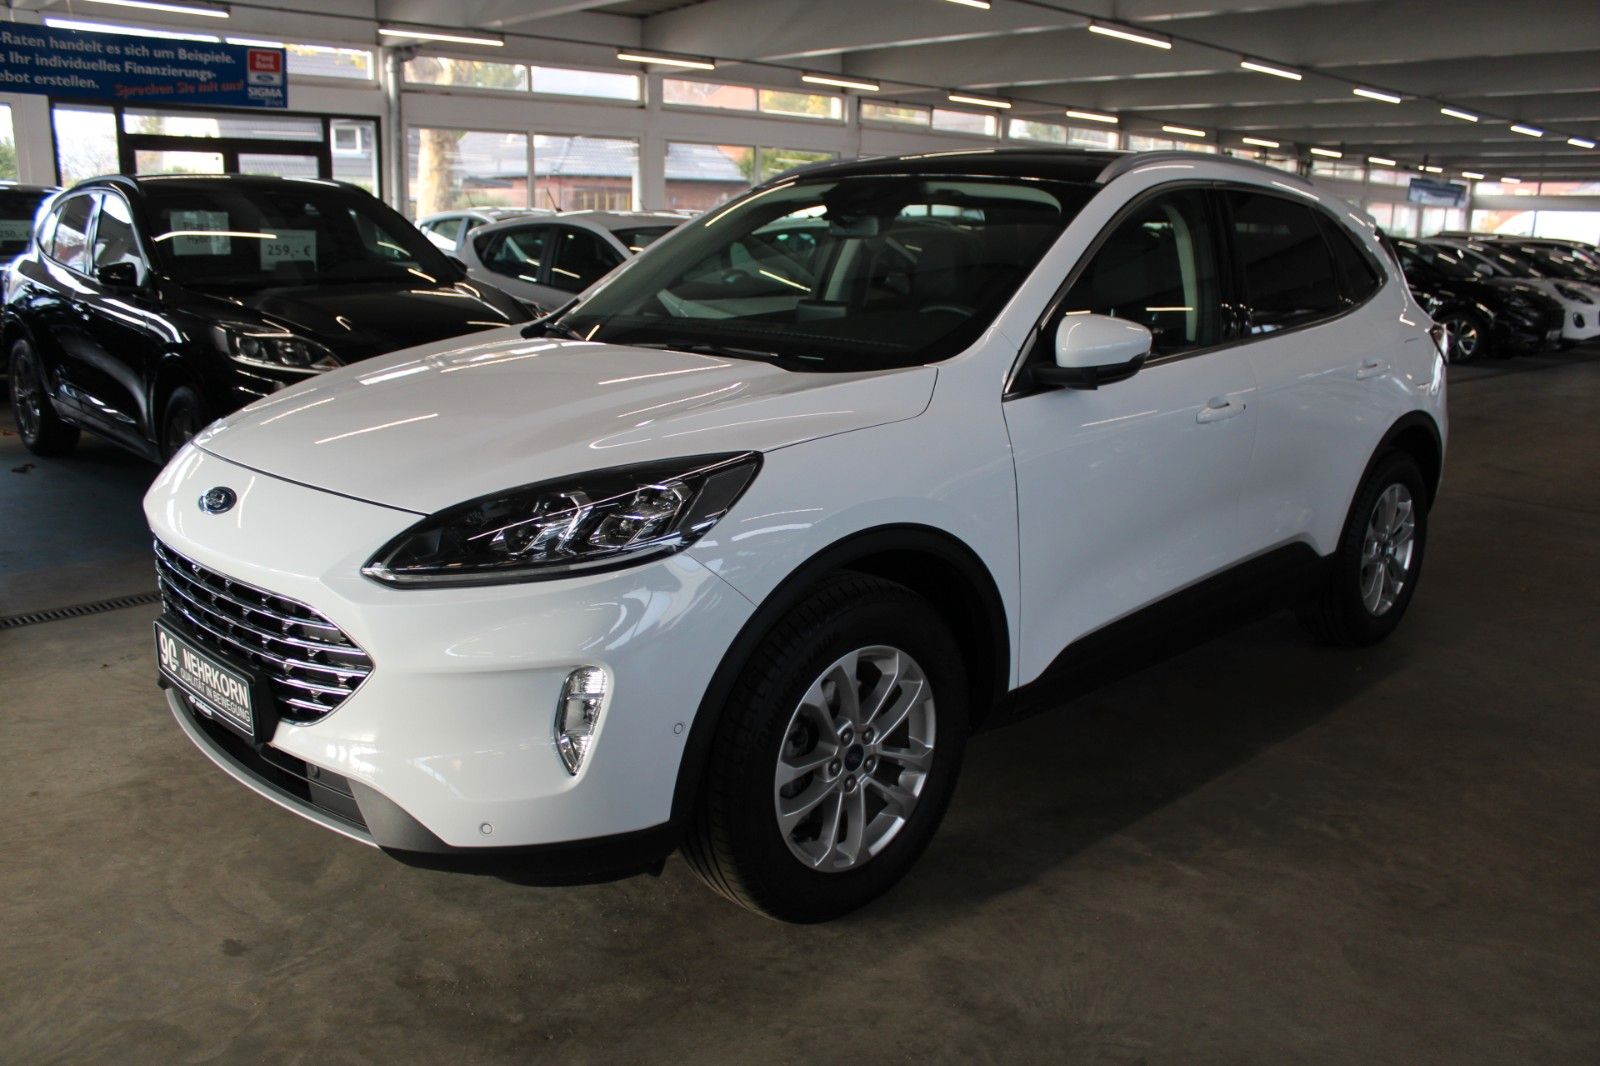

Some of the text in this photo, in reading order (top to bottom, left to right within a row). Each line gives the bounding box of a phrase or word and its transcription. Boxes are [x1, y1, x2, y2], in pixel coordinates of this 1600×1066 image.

[49, 36, 103, 53] handelt
[106, 44, 121, 55] es
[124, 44, 150, 57] sich
[153, 49, 175, 59] um
[178, 48, 236, 64] Beispiele.
[9, 51, 31, 64] Ihr
[35, 54, 121, 72] individuelles
[124, 61, 217, 82] Finanzierungs-
[33, 74, 99, 88] erstellen.
[113, 83, 174, 99] Sprechen
[176, 81, 195, 93] Sie
[198, 81, 218, 92] mit
[248, 87, 283, 98] SIGMA
[304, 245, 311, 257] €
[183, 648, 249, 709] NEHRKORN
[213, 690, 251, 723] BEWEGUNG
